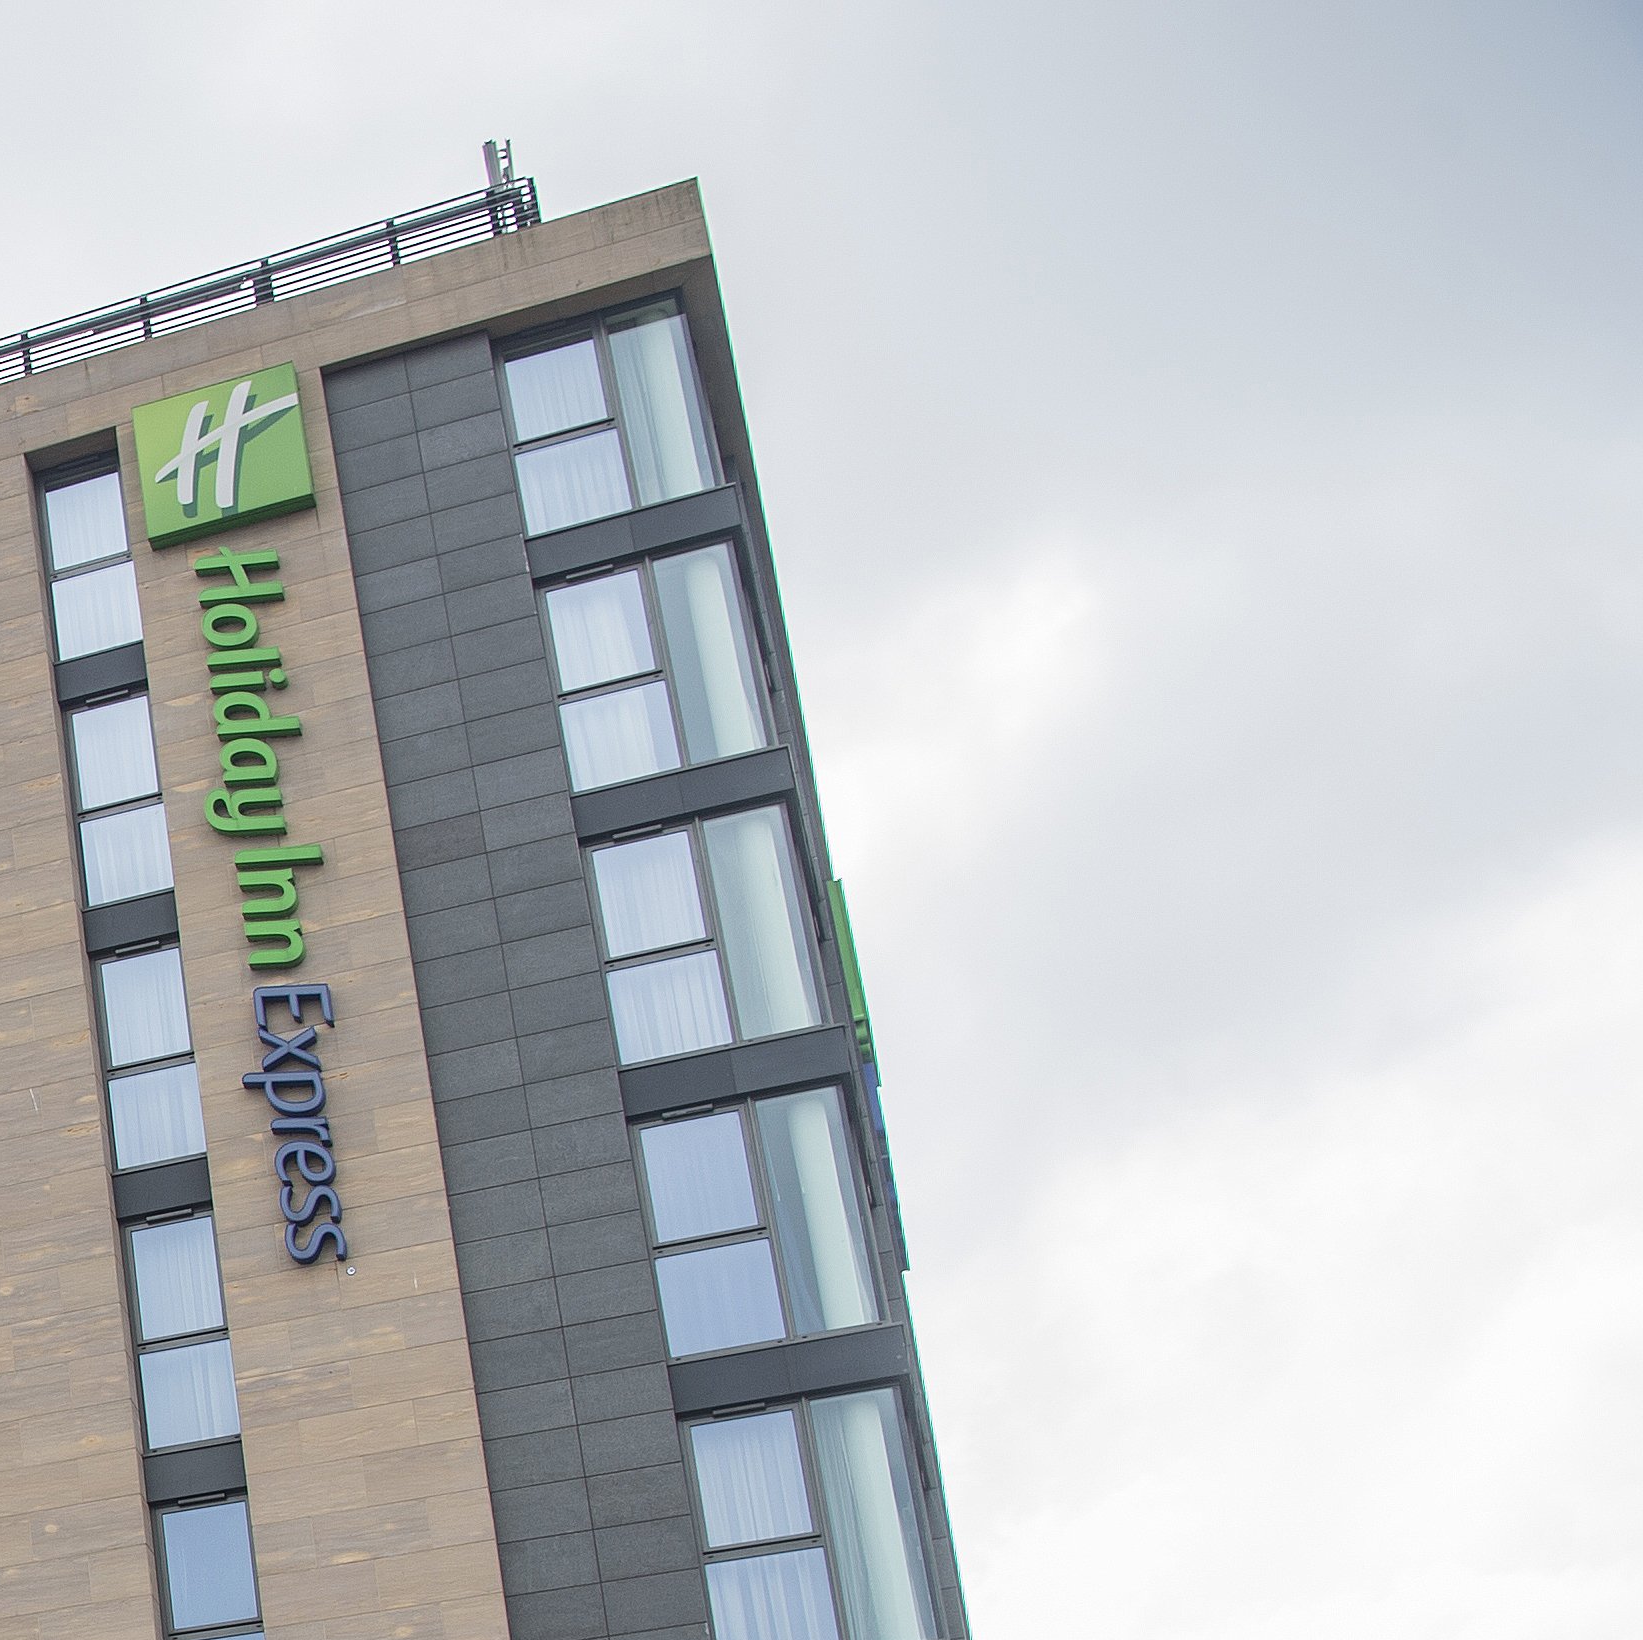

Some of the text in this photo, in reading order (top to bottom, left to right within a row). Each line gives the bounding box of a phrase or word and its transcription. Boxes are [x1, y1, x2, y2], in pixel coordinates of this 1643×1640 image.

[193, 546, 348, 1265] Holiday Inn Express
